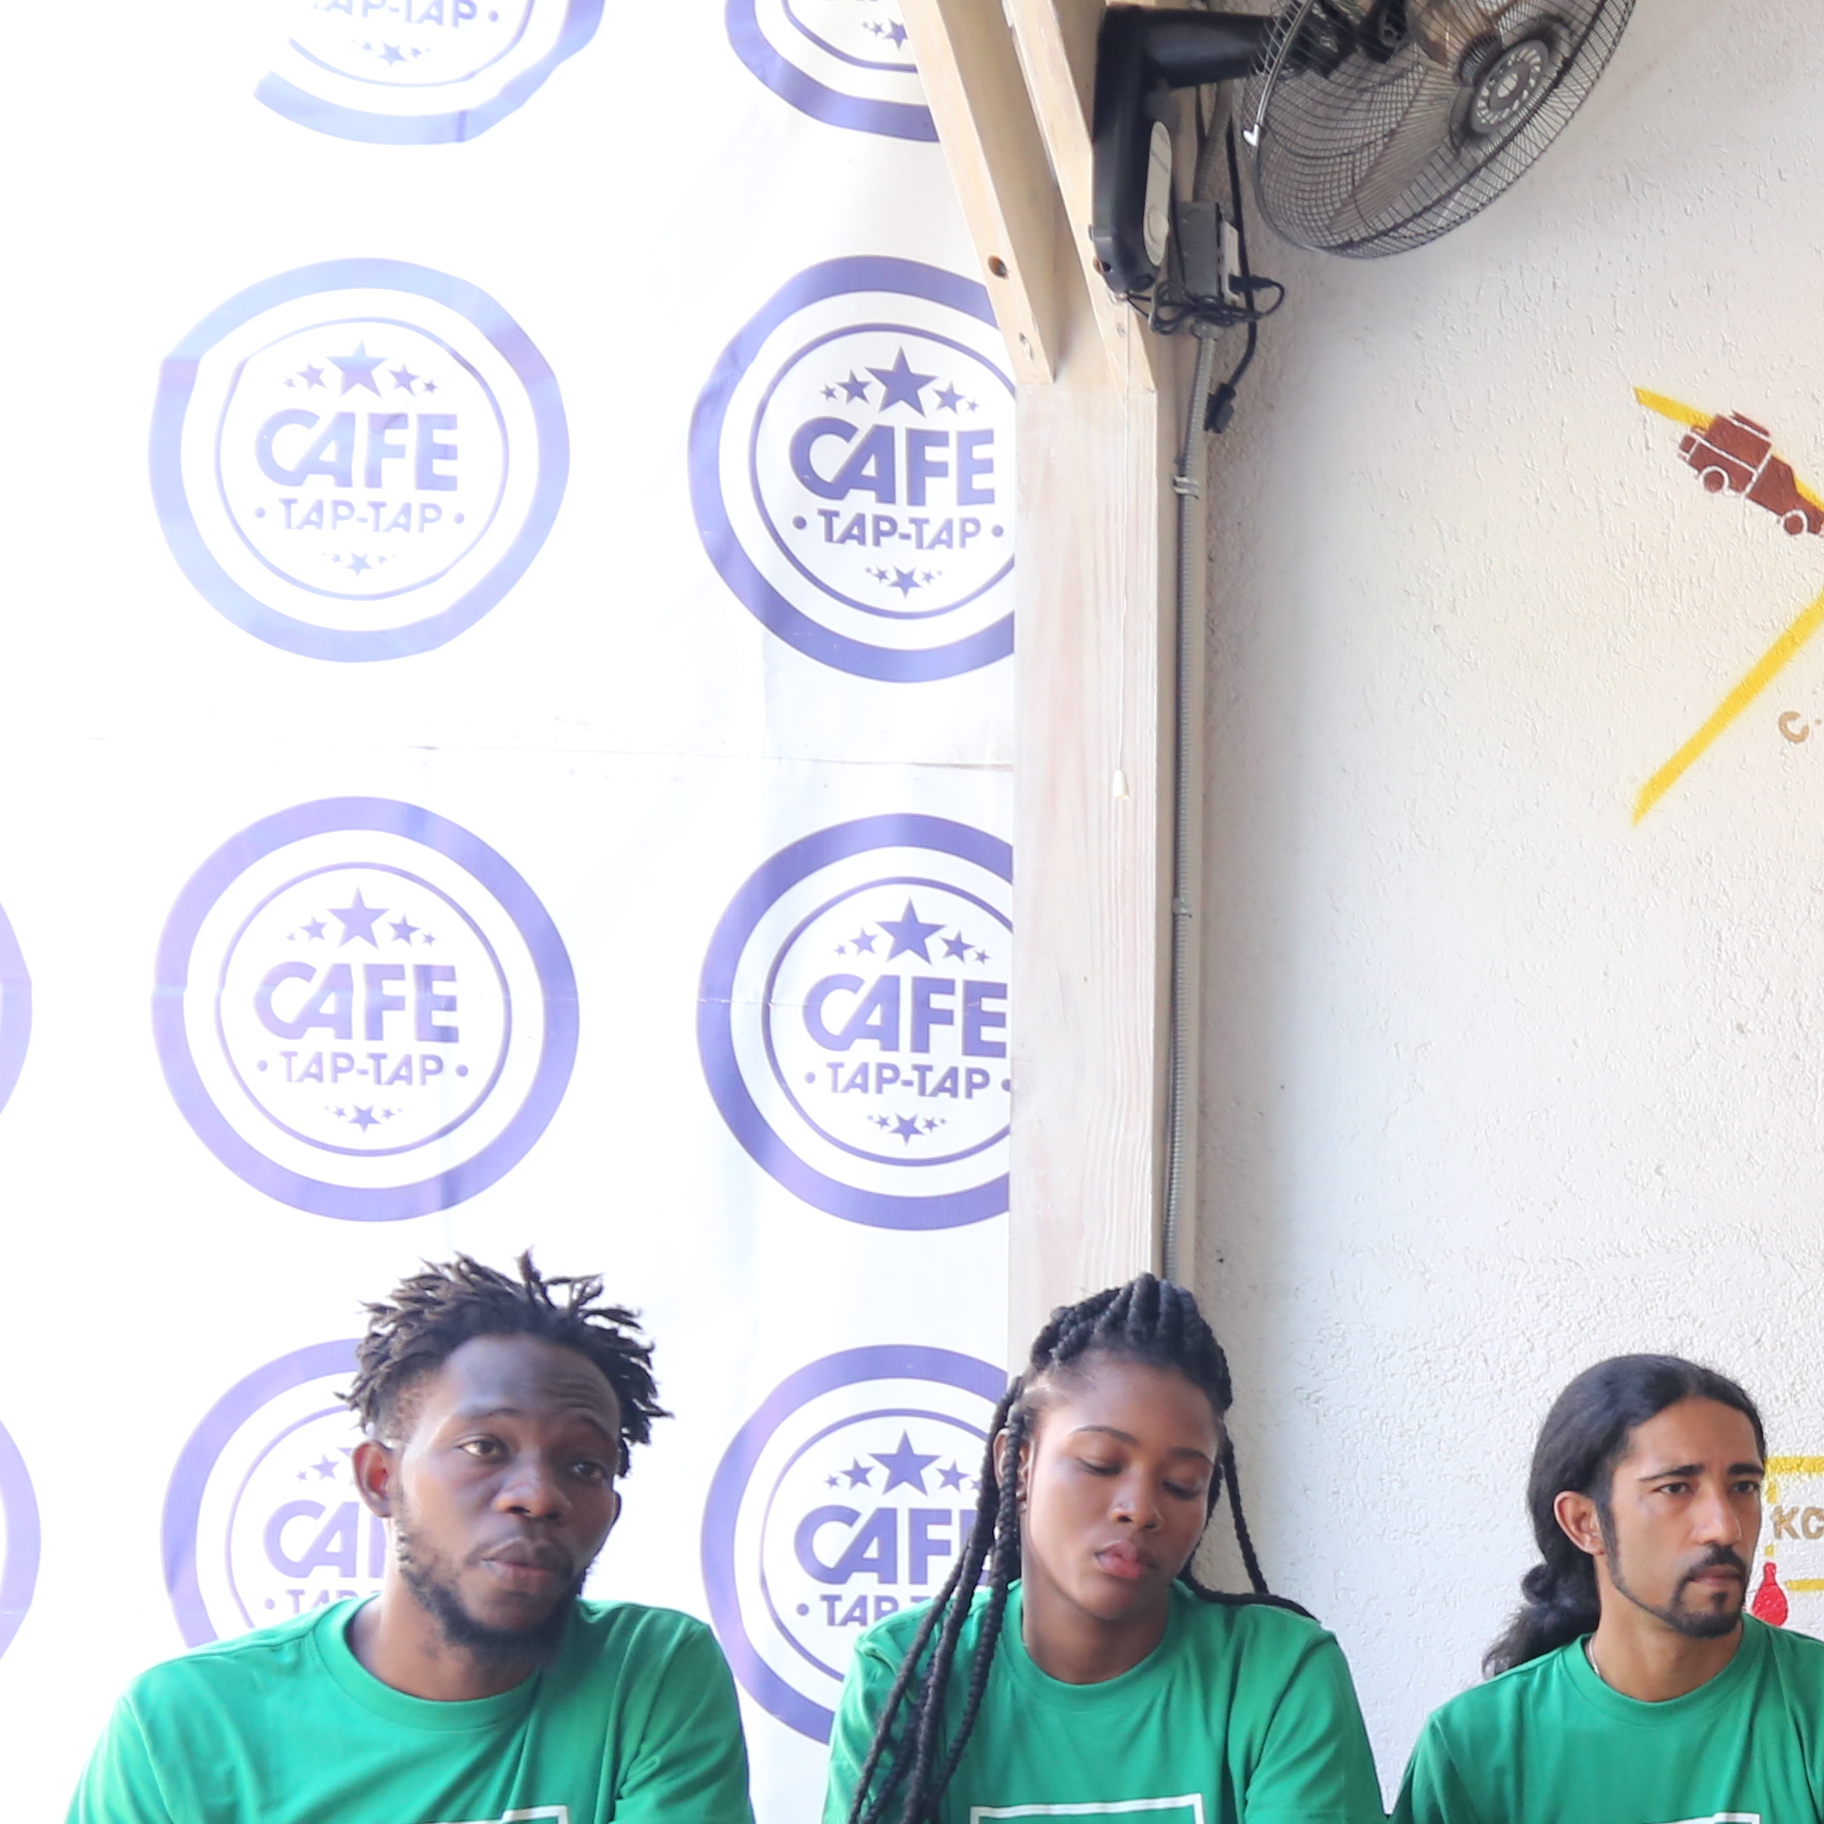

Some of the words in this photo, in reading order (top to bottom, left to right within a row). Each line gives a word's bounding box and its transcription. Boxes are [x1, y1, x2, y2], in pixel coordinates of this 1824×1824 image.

[255, 408, 459, 491] CAFE
[789, 416, 996, 505] CAFE
[279, 497, 443, 533] TAP-TAP
[817, 509, 982, 550] TAP-TAP
[253, 960, 461, 1045] CAFE
[802, 972, 1008, 1058] CAFE
[280, 1050, 445, 1087] TAP-TAP
[826, 1061, 991, 1100] TAP-TAP
[263, 1499, 388, 1580] CA
